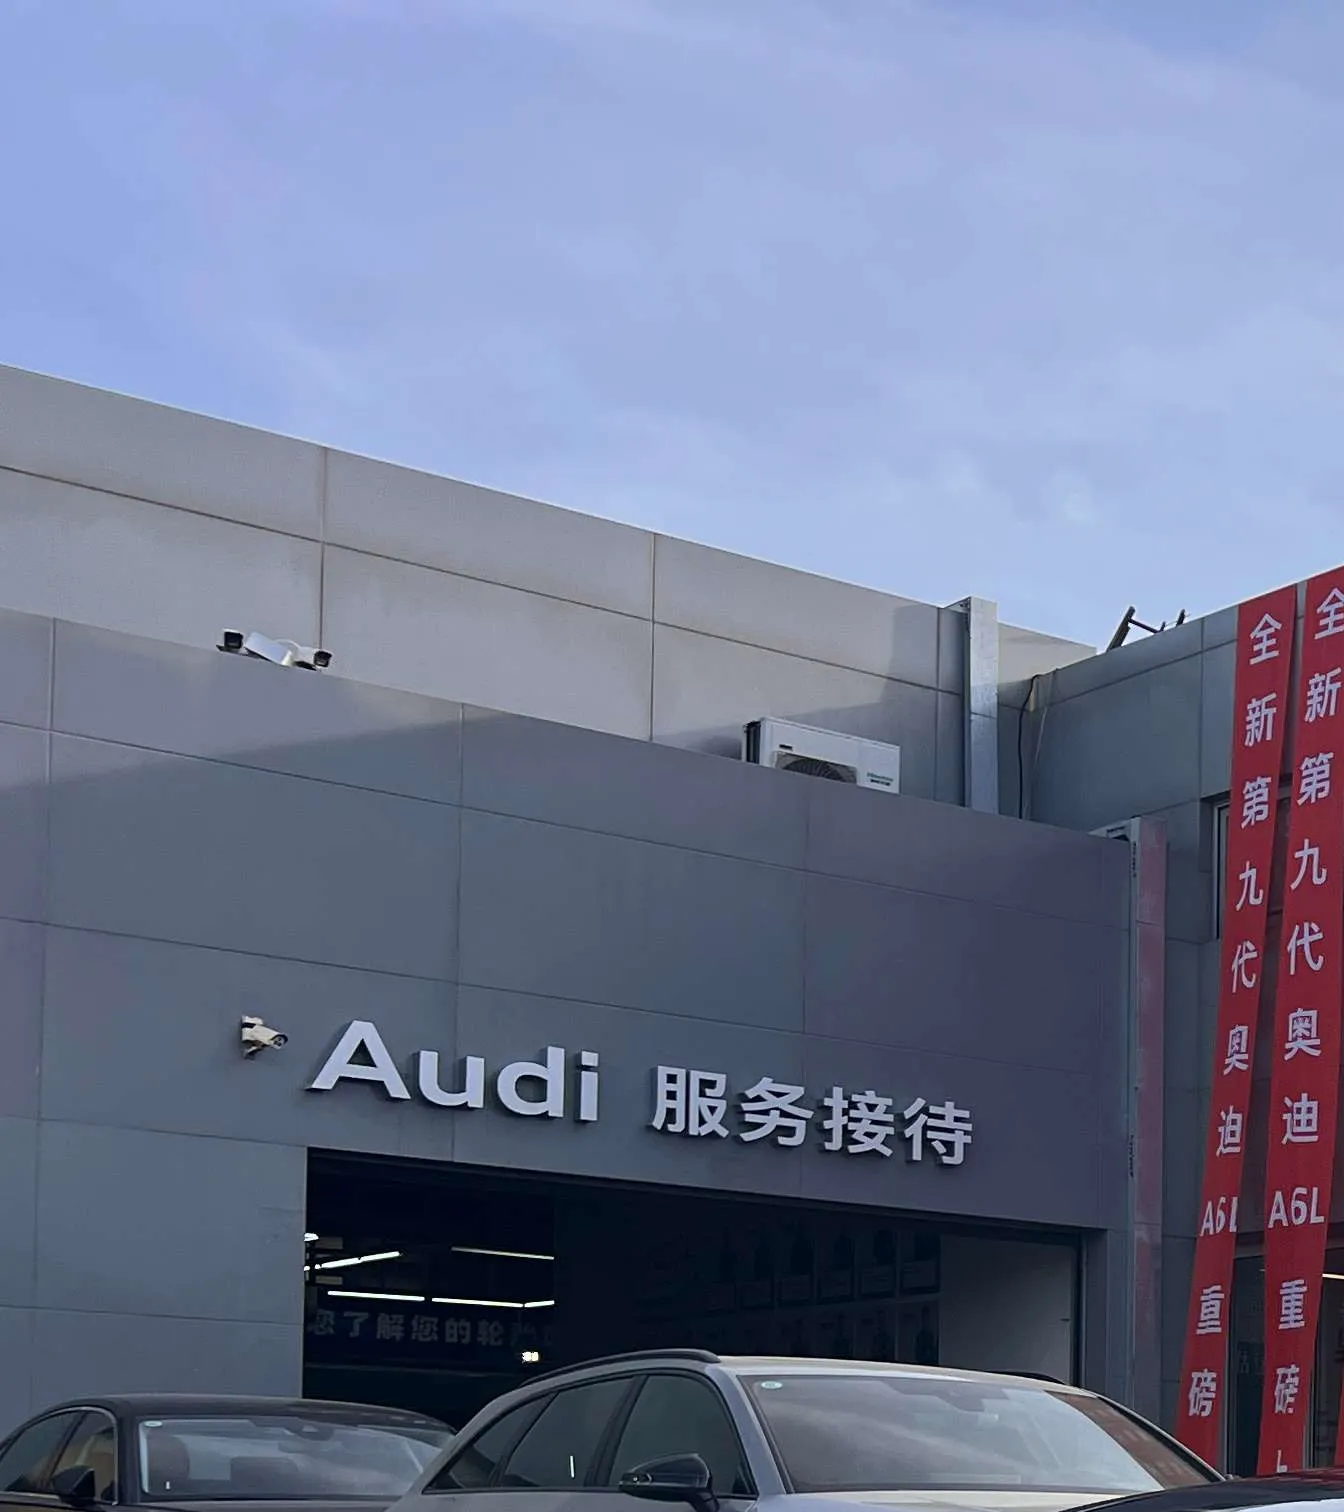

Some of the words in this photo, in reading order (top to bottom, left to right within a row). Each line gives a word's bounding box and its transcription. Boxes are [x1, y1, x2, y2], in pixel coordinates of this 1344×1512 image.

[309, 1019, 598, 1122] Audi
[650, 1065, 974, 1166] 服务接待
